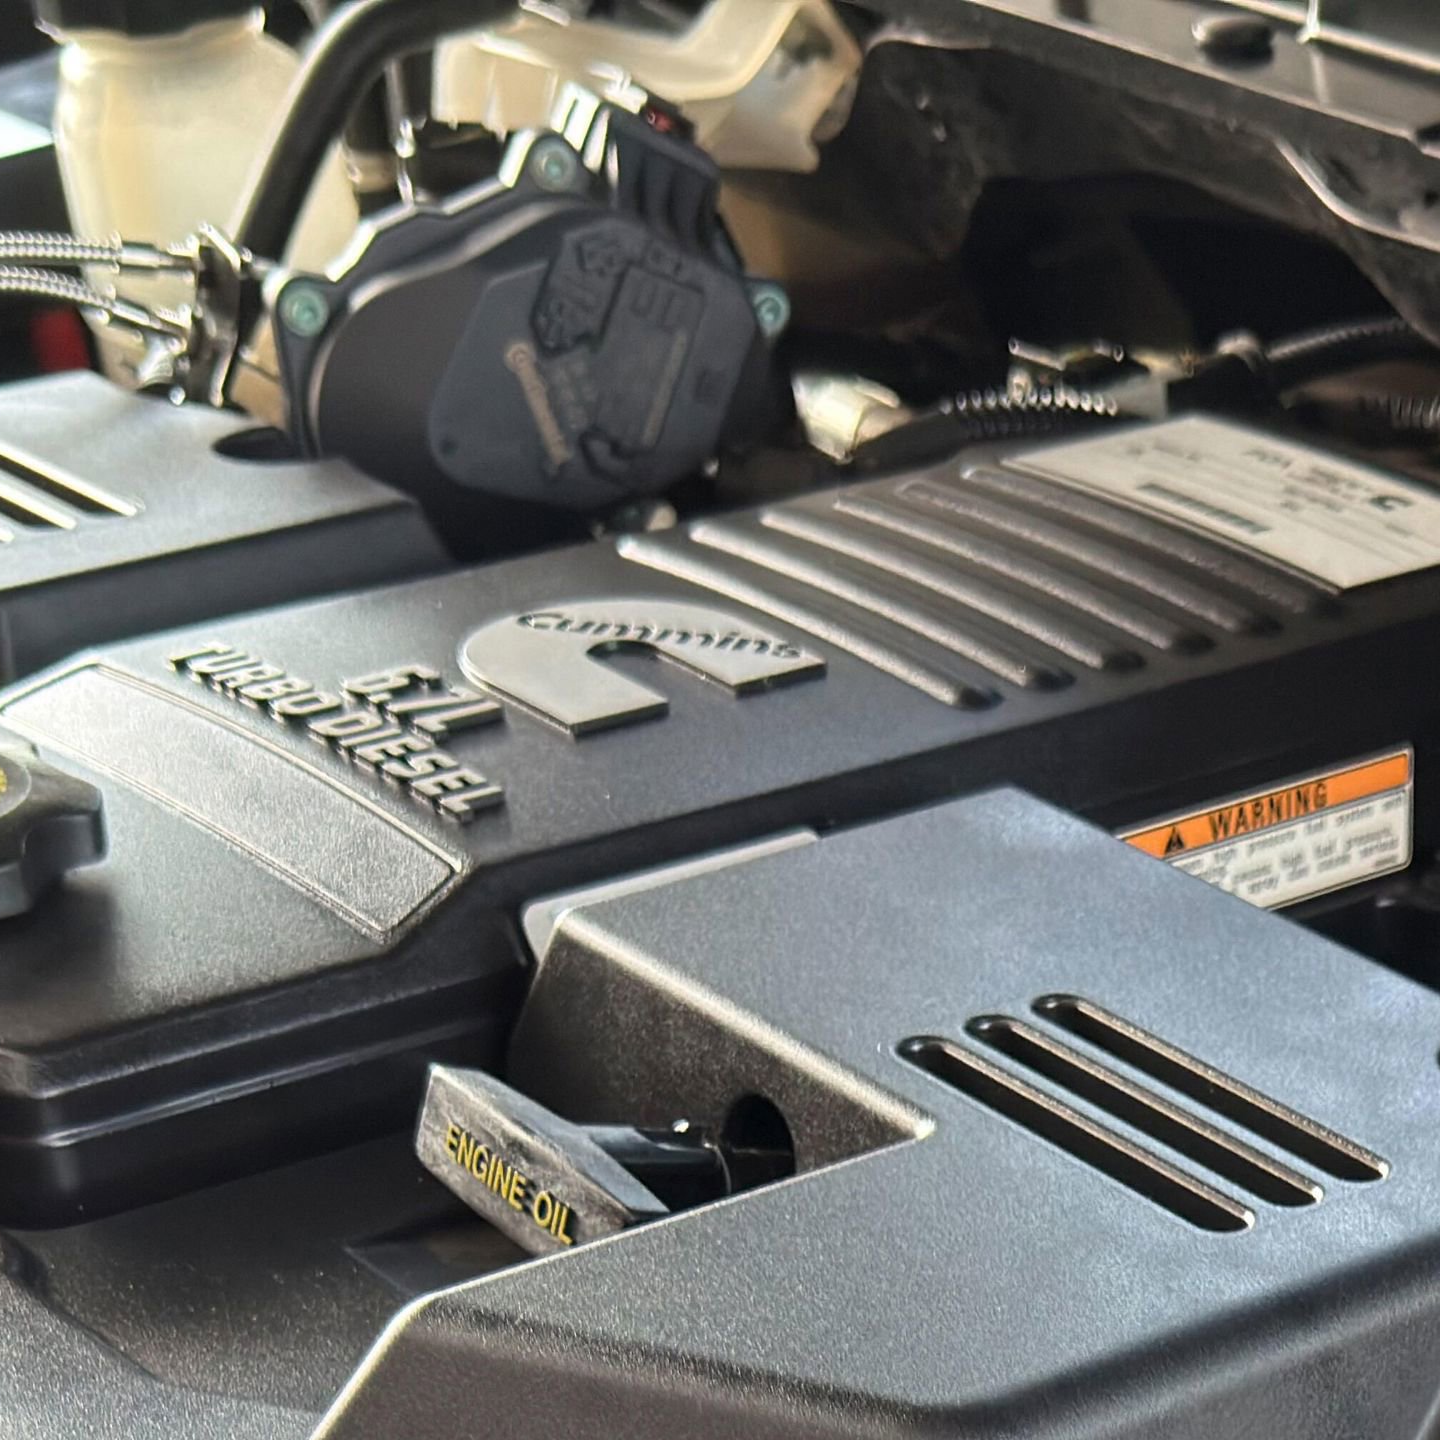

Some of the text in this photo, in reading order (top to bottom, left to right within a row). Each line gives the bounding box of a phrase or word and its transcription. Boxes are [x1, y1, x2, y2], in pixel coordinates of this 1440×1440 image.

[517, 612, 804, 659] Cummins
[168, 642, 504, 824] TURBO DIESEL
[343, 664, 503, 742] 6.7L
[1210, 783, 1329, 842] WARNING
[445, 1121, 574, 1247] ENGINE OIL
